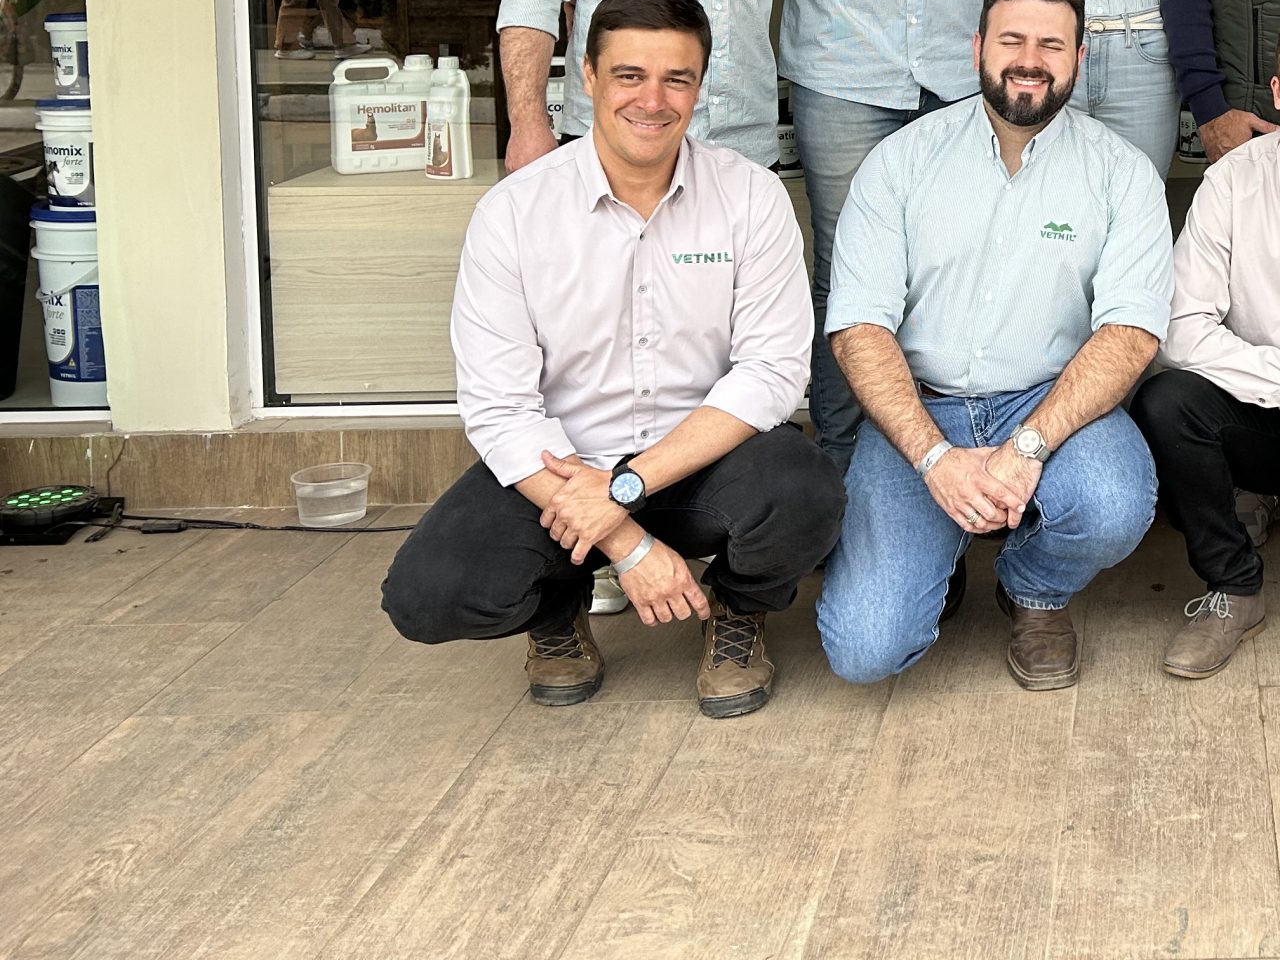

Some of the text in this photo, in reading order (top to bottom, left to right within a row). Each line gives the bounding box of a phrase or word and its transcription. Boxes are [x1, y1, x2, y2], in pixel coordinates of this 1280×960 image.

[357, 103, 416, 115] Hemolitan
[61, 156, 83, 168] forte
[1040, 230, 1077, 242] VETNIL
[671, 252, 733, 264] VETNIL
[45, 306, 65, 320] forte
